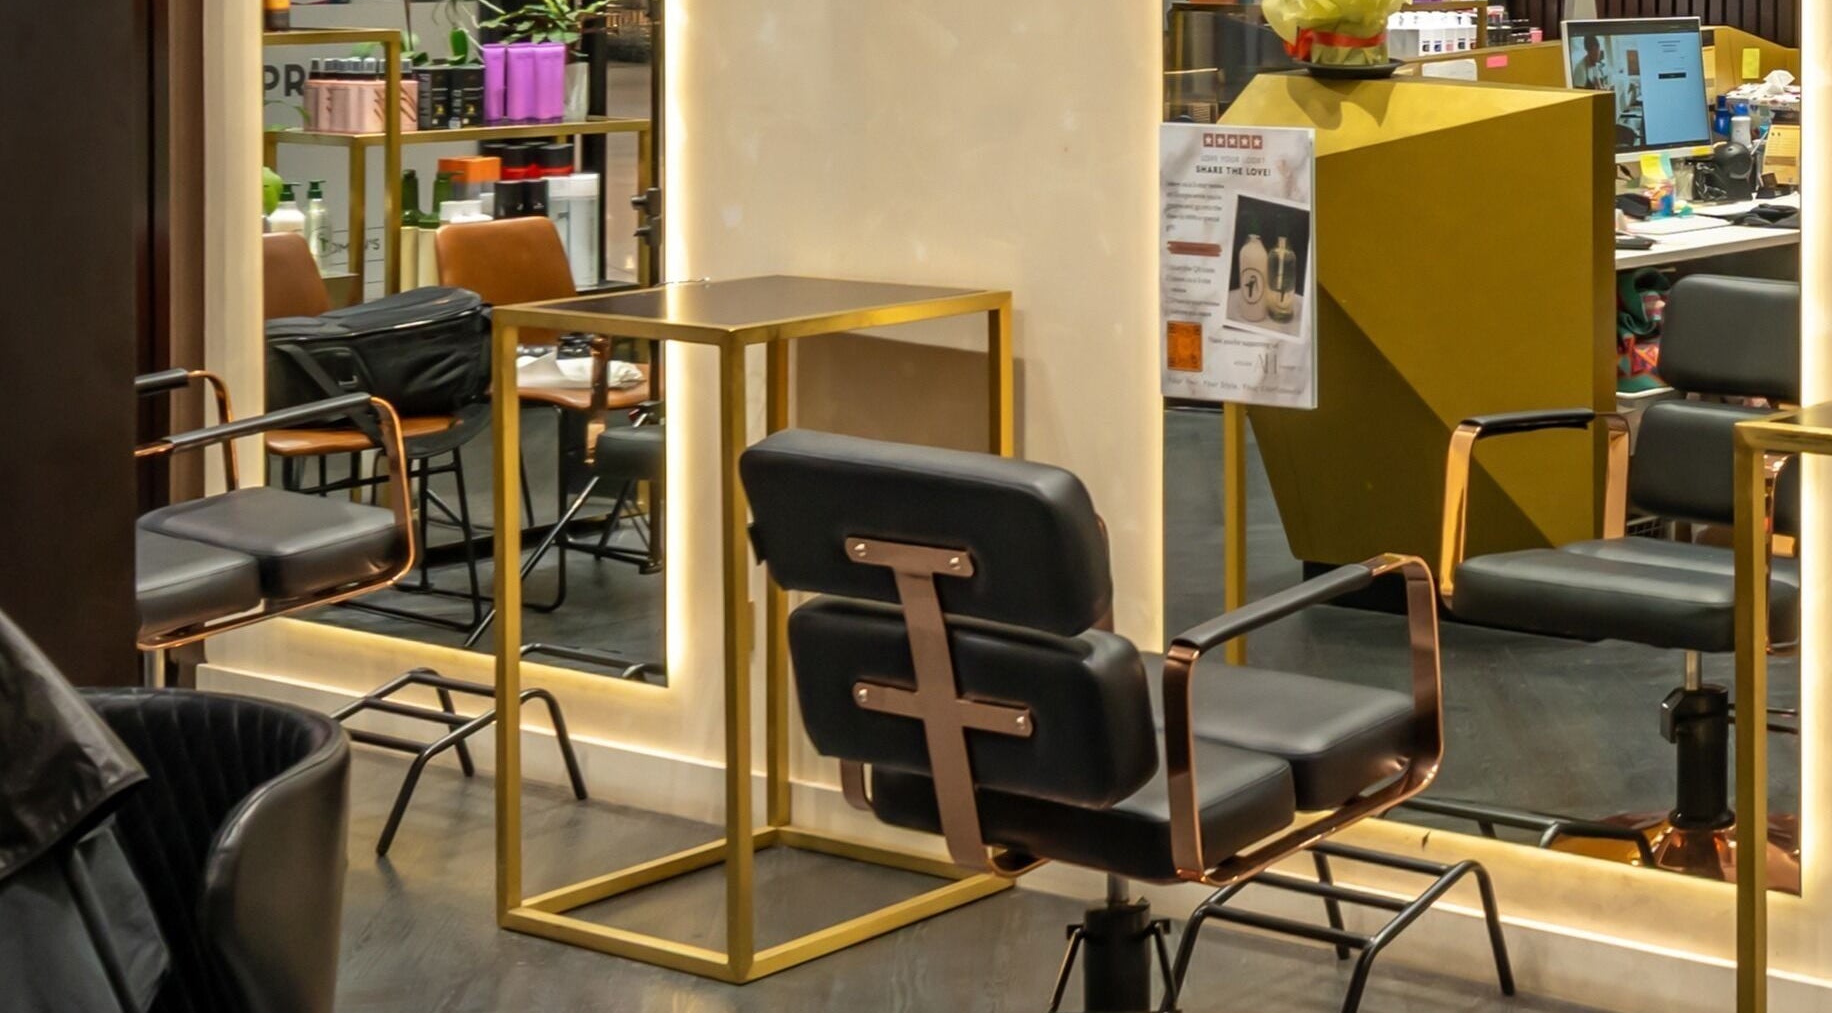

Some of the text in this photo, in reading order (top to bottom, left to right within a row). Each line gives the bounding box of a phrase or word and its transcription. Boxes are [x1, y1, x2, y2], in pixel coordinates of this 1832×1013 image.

[1196, 165, 1272, 177] SHARE THE LOVE!
